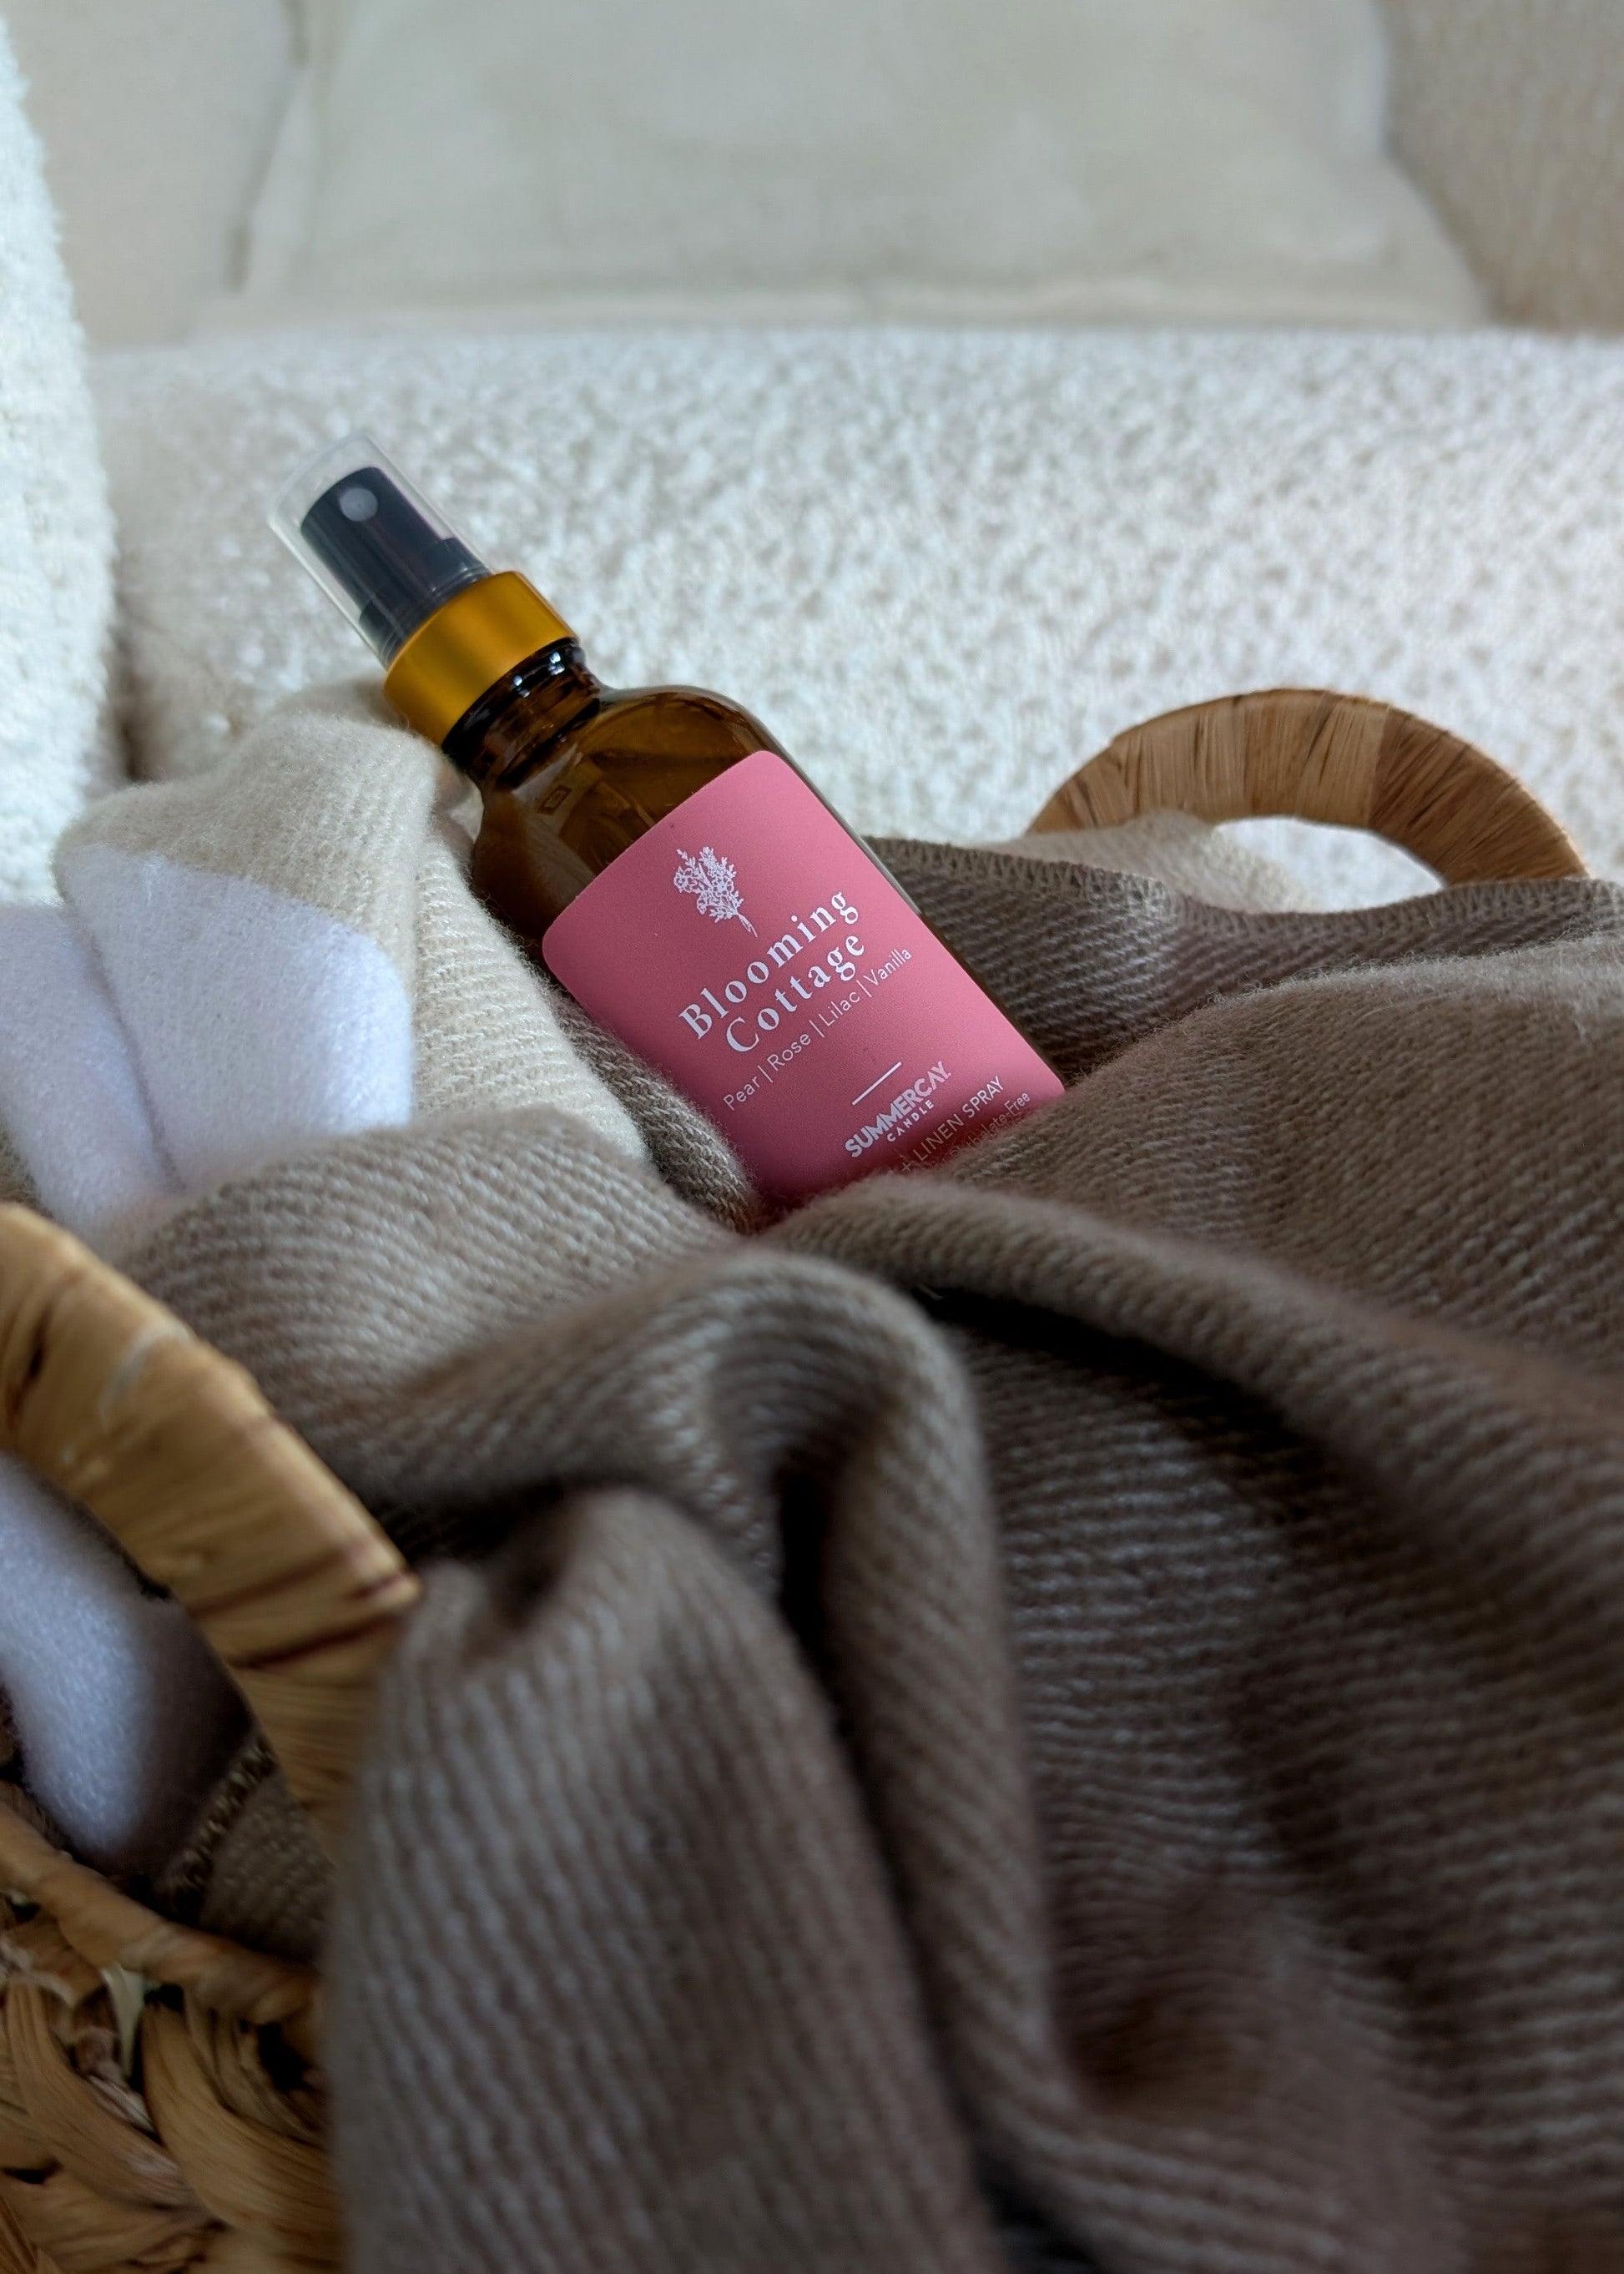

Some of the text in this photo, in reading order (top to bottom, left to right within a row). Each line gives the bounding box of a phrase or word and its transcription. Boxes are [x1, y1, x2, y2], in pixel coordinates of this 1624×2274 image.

[678, 892, 858, 1039] Blooming
[726, 935, 864, 1051] Cottage
[724, 1076, 759, 1110] Pear
[767, 1033, 810, 1071] Rose
[818, 991, 860, 1026] Lilac
[863, 948, 911, 986] Vanilla
[886, 1099, 934, 1142] CANDLE
[913, 1113, 964, 1161] LINEN
[962, 1076, 1003, 1118] SPRAY
